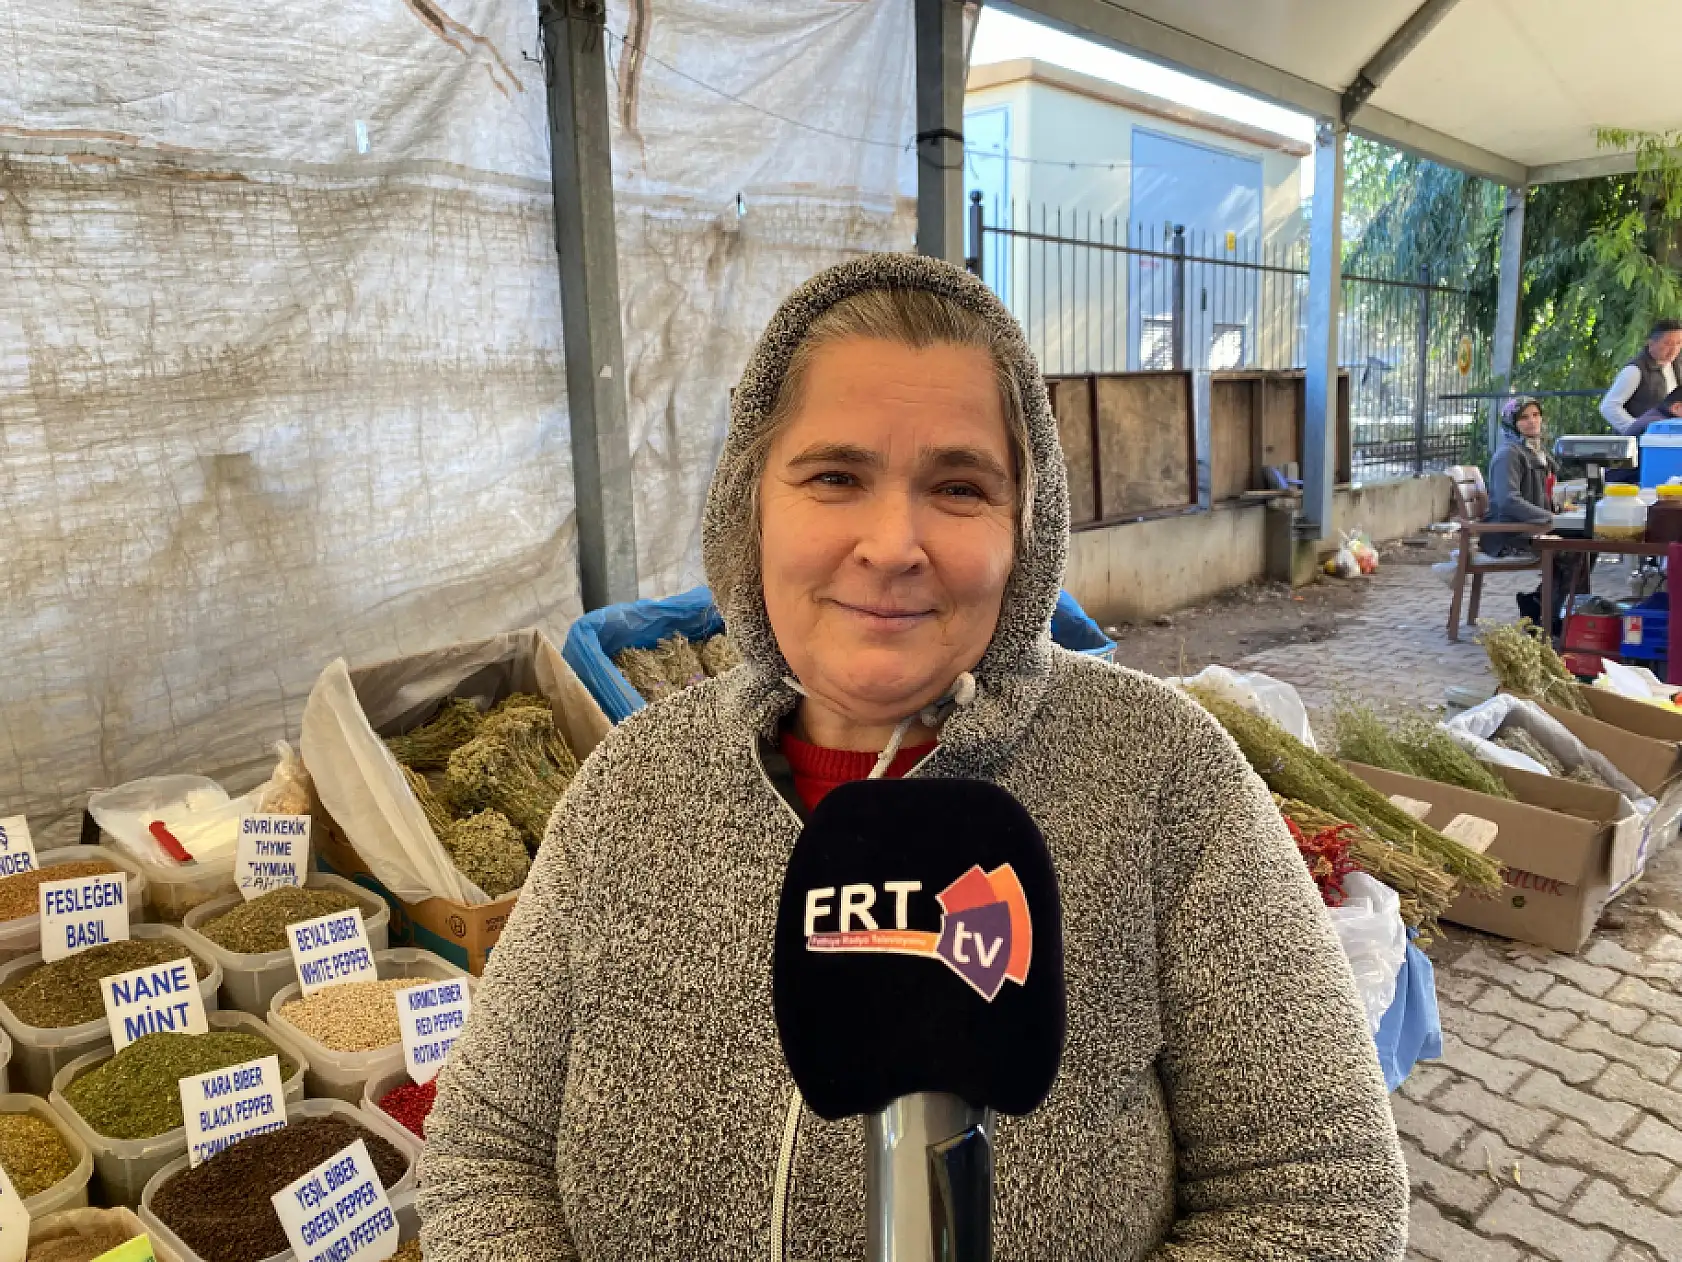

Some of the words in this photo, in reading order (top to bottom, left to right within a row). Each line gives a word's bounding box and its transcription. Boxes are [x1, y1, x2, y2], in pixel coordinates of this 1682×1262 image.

[255, 840, 292, 856] THYME
[248, 861, 297, 877] THYMIAN
[45, 879, 123, 916] FESLEĞEN
[804, 881, 923, 937] FRT
[65, 920, 110, 949] BASIL
[296, 923, 329, 952] BEYAZ
[952, 921, 1004, 968] tv
[300, 956, 334, 985] WHITE
[331, 947, 372, 977] PEPPER
[111, 965, 190, 1007] NANE
[124, 1002, 189, 1042] MİNT
[415, 1016, 433, 1037] RED
[202, 1074, 232, 1101] KARA
[200, 1103, 235, 1132] BLACK
[234, 1093, 275, 1123] PEPPER
[301, 1207, 340, 1246] GREEN
[335, 1180, 378, 1224] PEPPER
